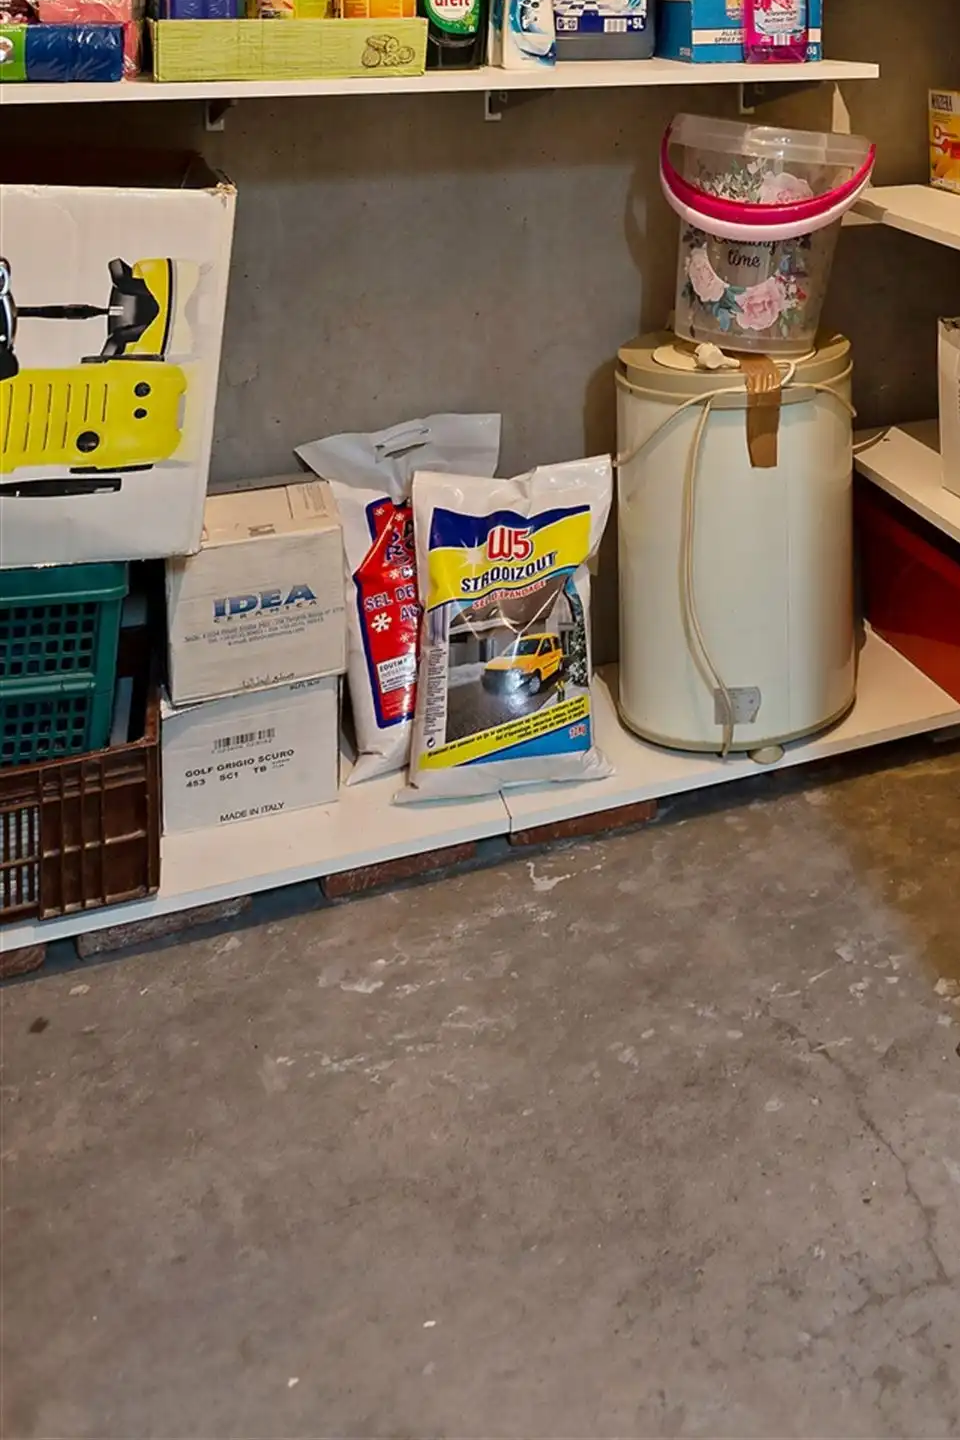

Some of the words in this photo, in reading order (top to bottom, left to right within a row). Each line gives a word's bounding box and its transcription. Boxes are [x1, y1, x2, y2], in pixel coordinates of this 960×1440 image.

[727, 247, 761, 268] time
[487, 526, 533, 561] W5
[460, 552, 556, 593] STROOIZOUT
[213, 582, 319, 618] IDEA
[213, 600, 318, 623] CERAMICA
[364, 594, 394, 612] SEL
[184, 766, 214, 779] GOLF
[216, 757, 256, 772] GRIGIO
[257, 748, 295, 764] SCURO
[219, 809, 248, 823] MADE
[249, 806, 259, 816] IN
[260, 801, 286, 814] ITALY
